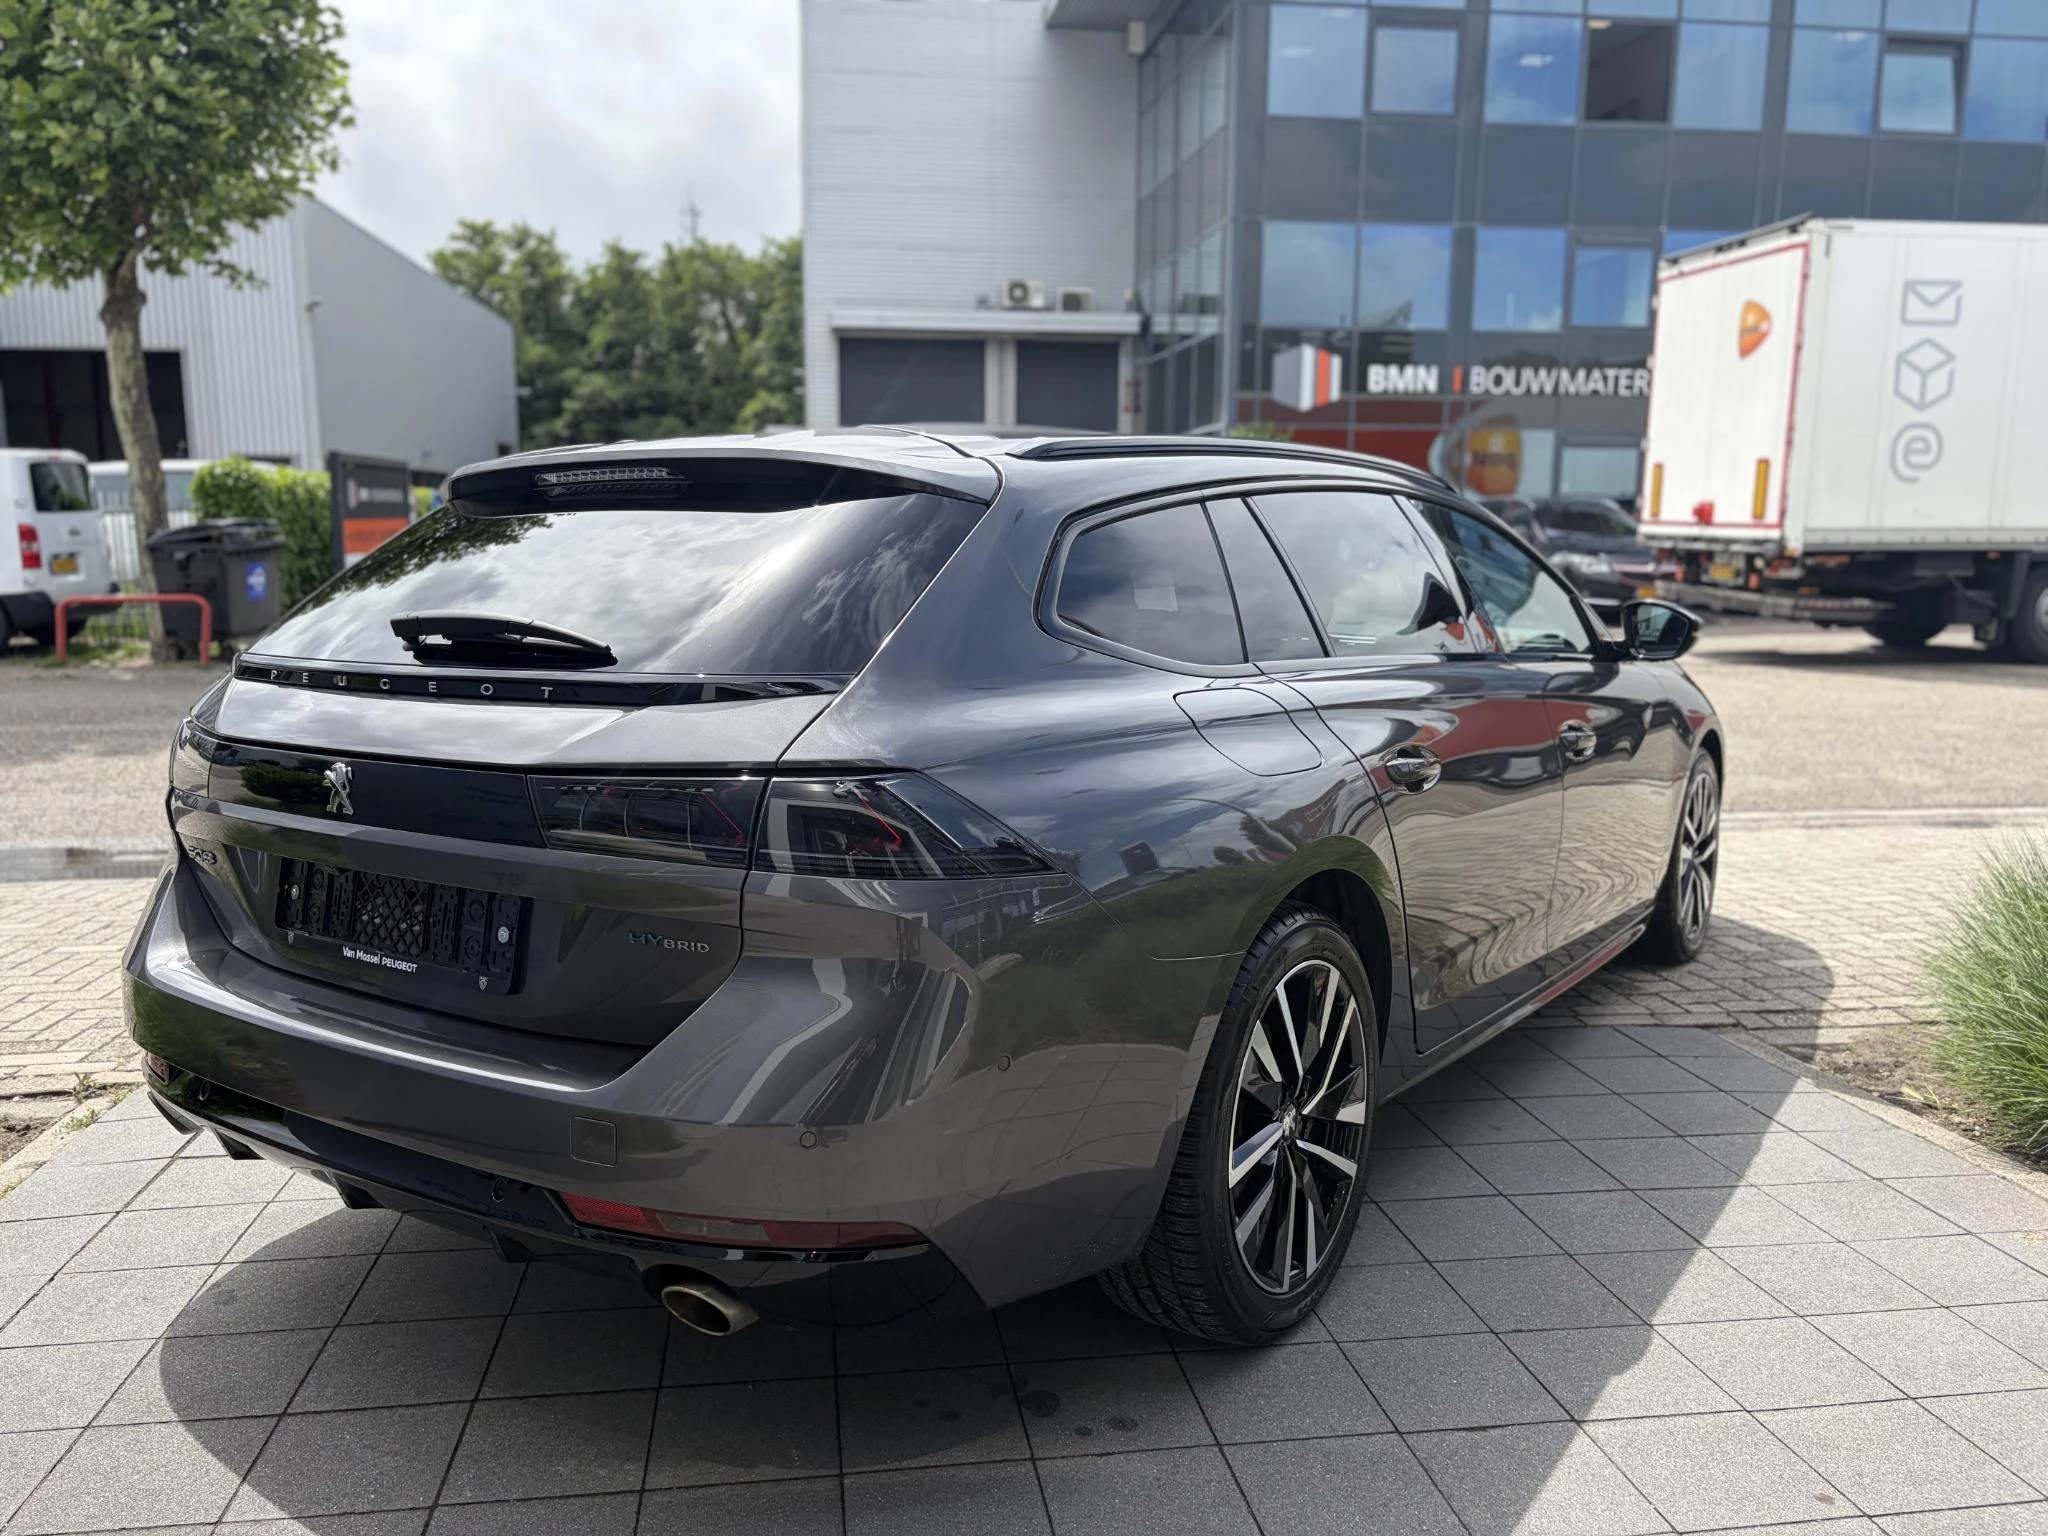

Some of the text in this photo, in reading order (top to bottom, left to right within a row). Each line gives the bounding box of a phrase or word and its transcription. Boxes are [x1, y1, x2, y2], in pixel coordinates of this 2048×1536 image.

[1367, 364, 1650, 397] BMN BOUWMATER
[270, 669, 554, 699] PEUGEOT
[627, 930, 711, 953] HYBRID
[342, 945, 418, 973] Van Mossel PEUGEOT
